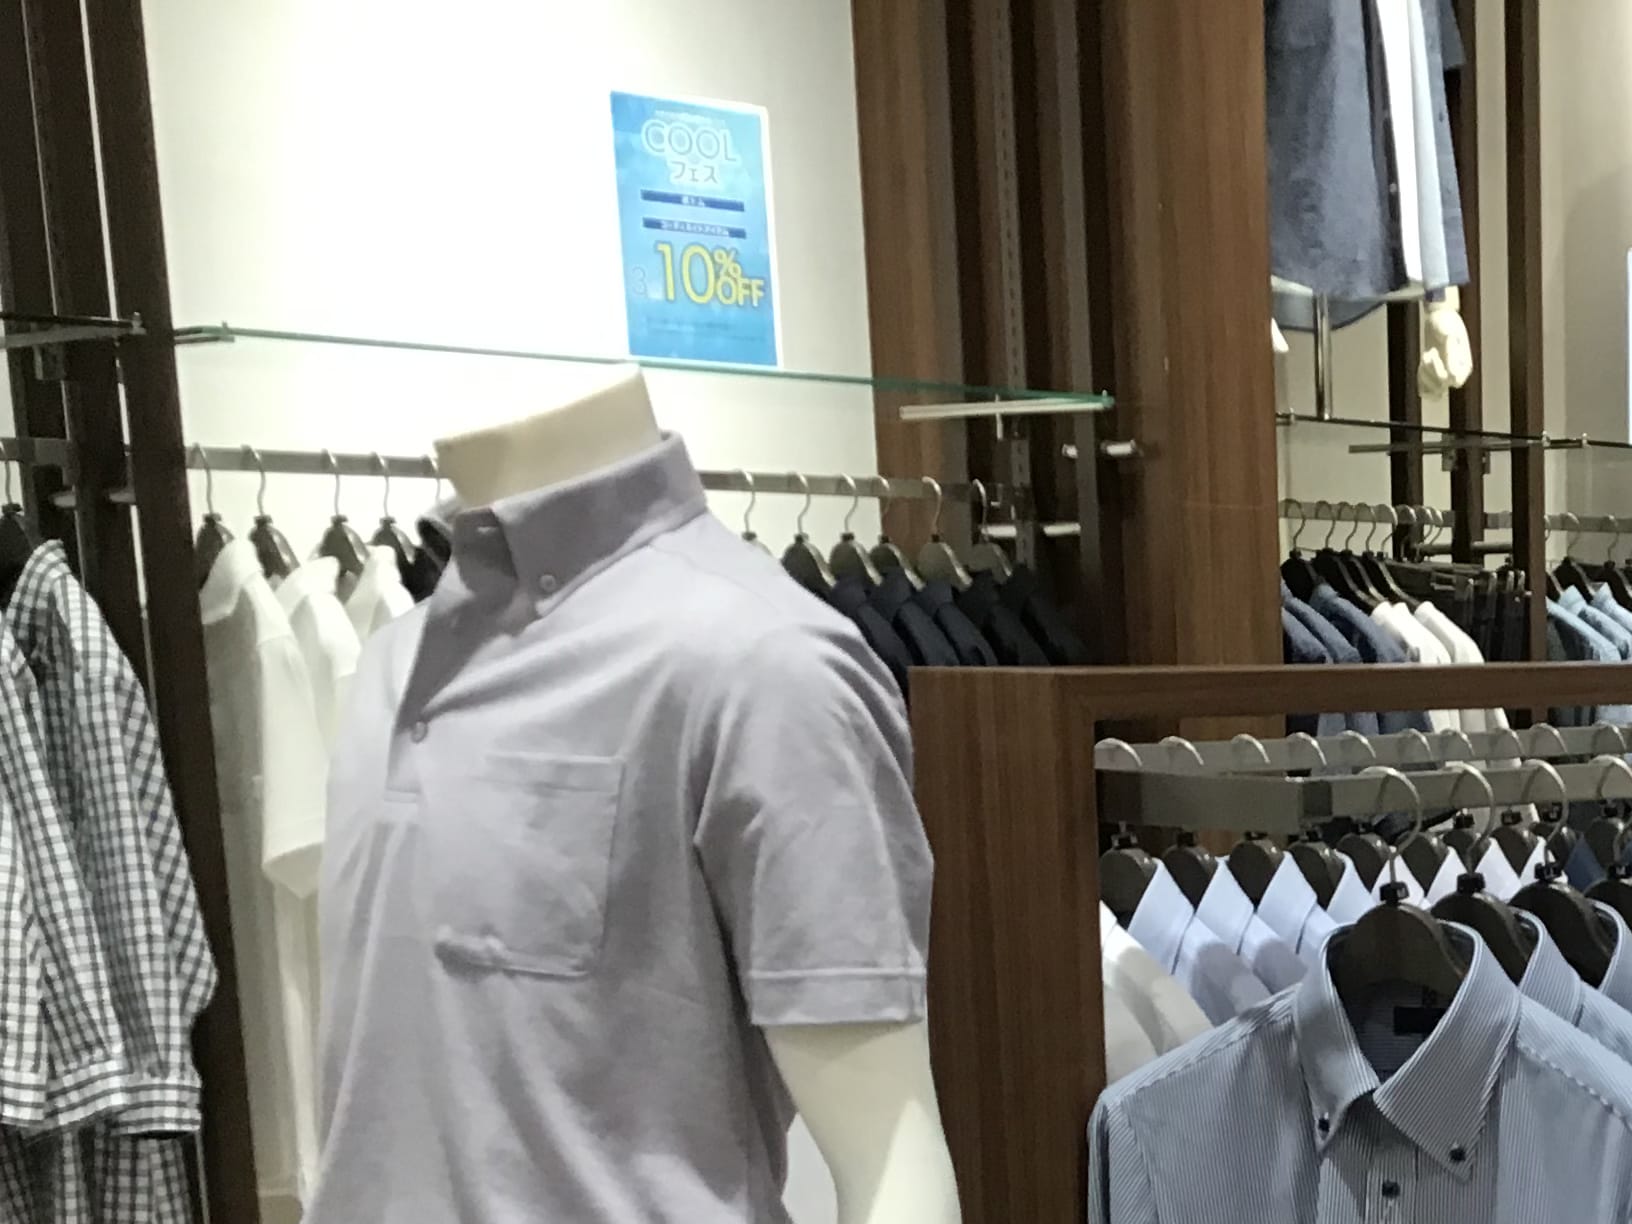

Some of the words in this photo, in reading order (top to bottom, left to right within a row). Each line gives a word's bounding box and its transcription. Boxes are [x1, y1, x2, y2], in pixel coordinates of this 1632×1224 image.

[643, 119, 738, 163] COOL
[669, 159, 719, 184] フェス
[715, 275, 765, 308] OFF
